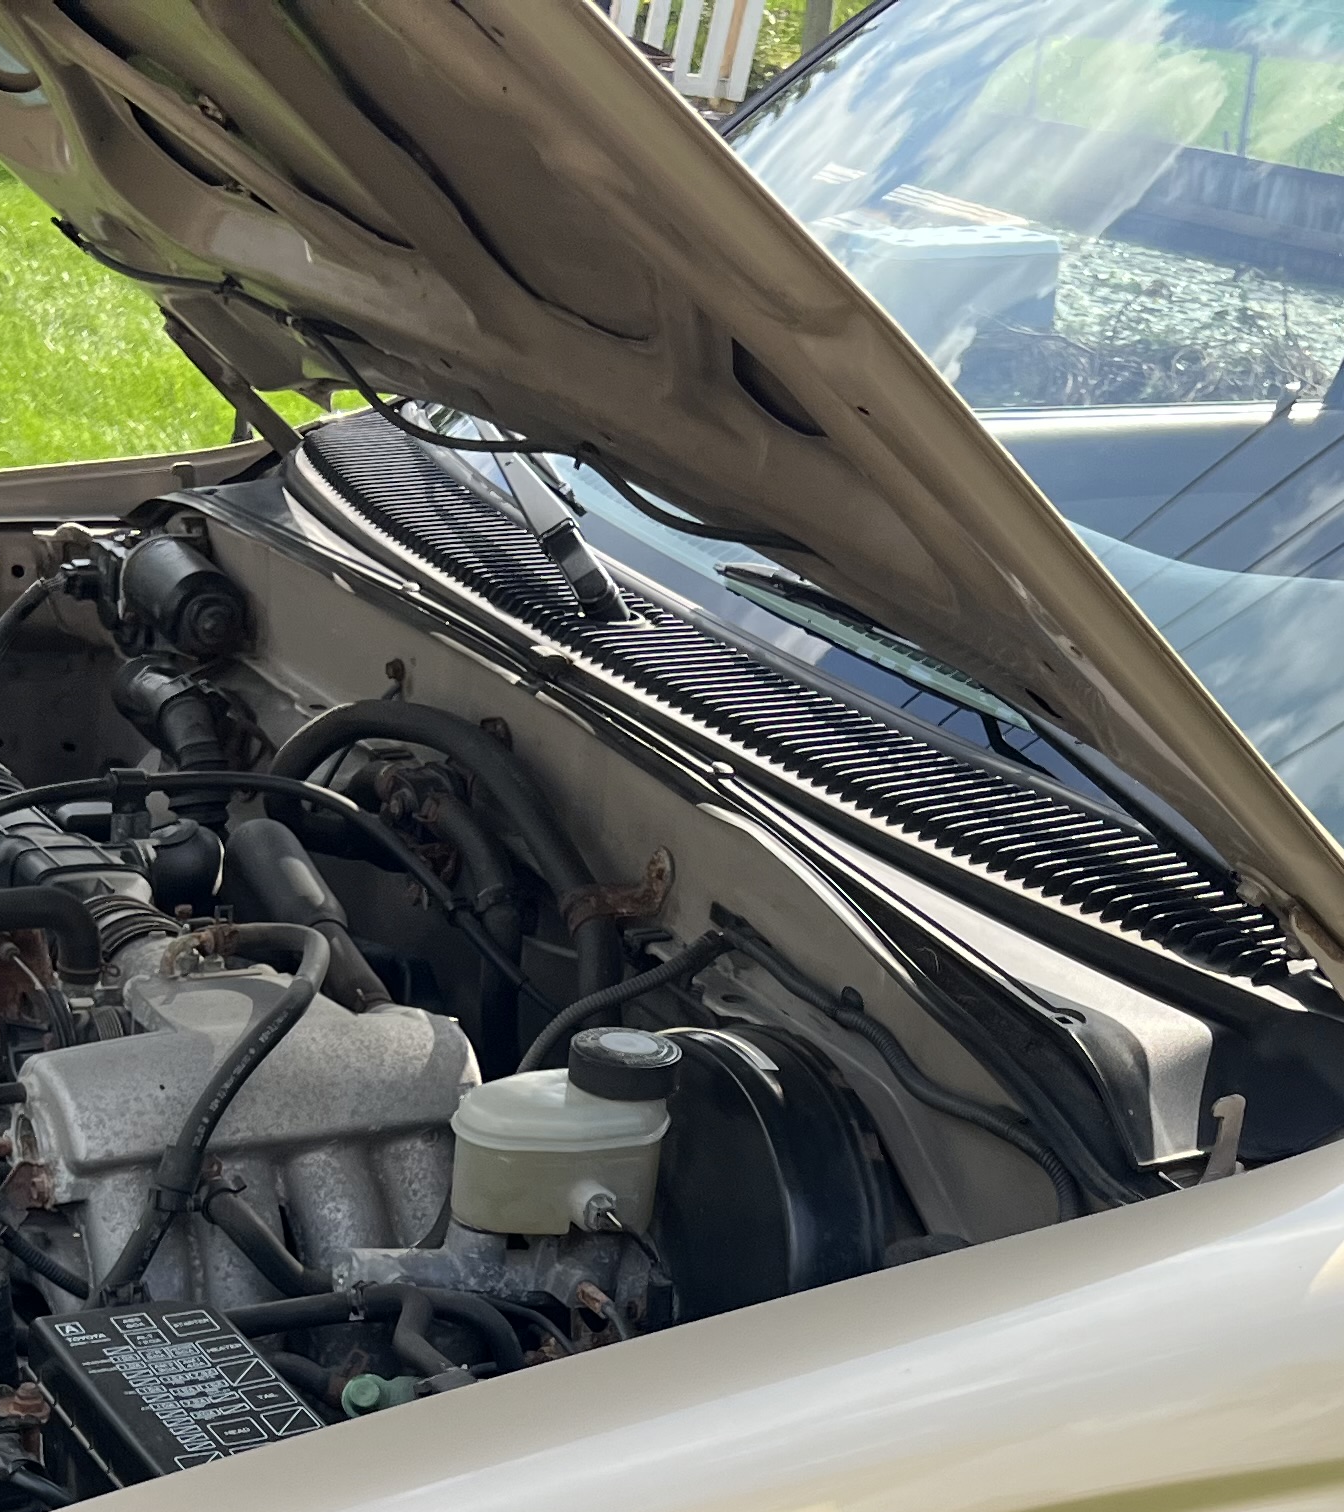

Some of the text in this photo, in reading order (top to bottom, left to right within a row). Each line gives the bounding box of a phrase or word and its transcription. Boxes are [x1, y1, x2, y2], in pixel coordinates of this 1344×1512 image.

[65, 1333, 107, 1342] TOYOTA
[206, 1343, 242, 1353] HEATER
[223, 1426, 251, 1436] HEAD
